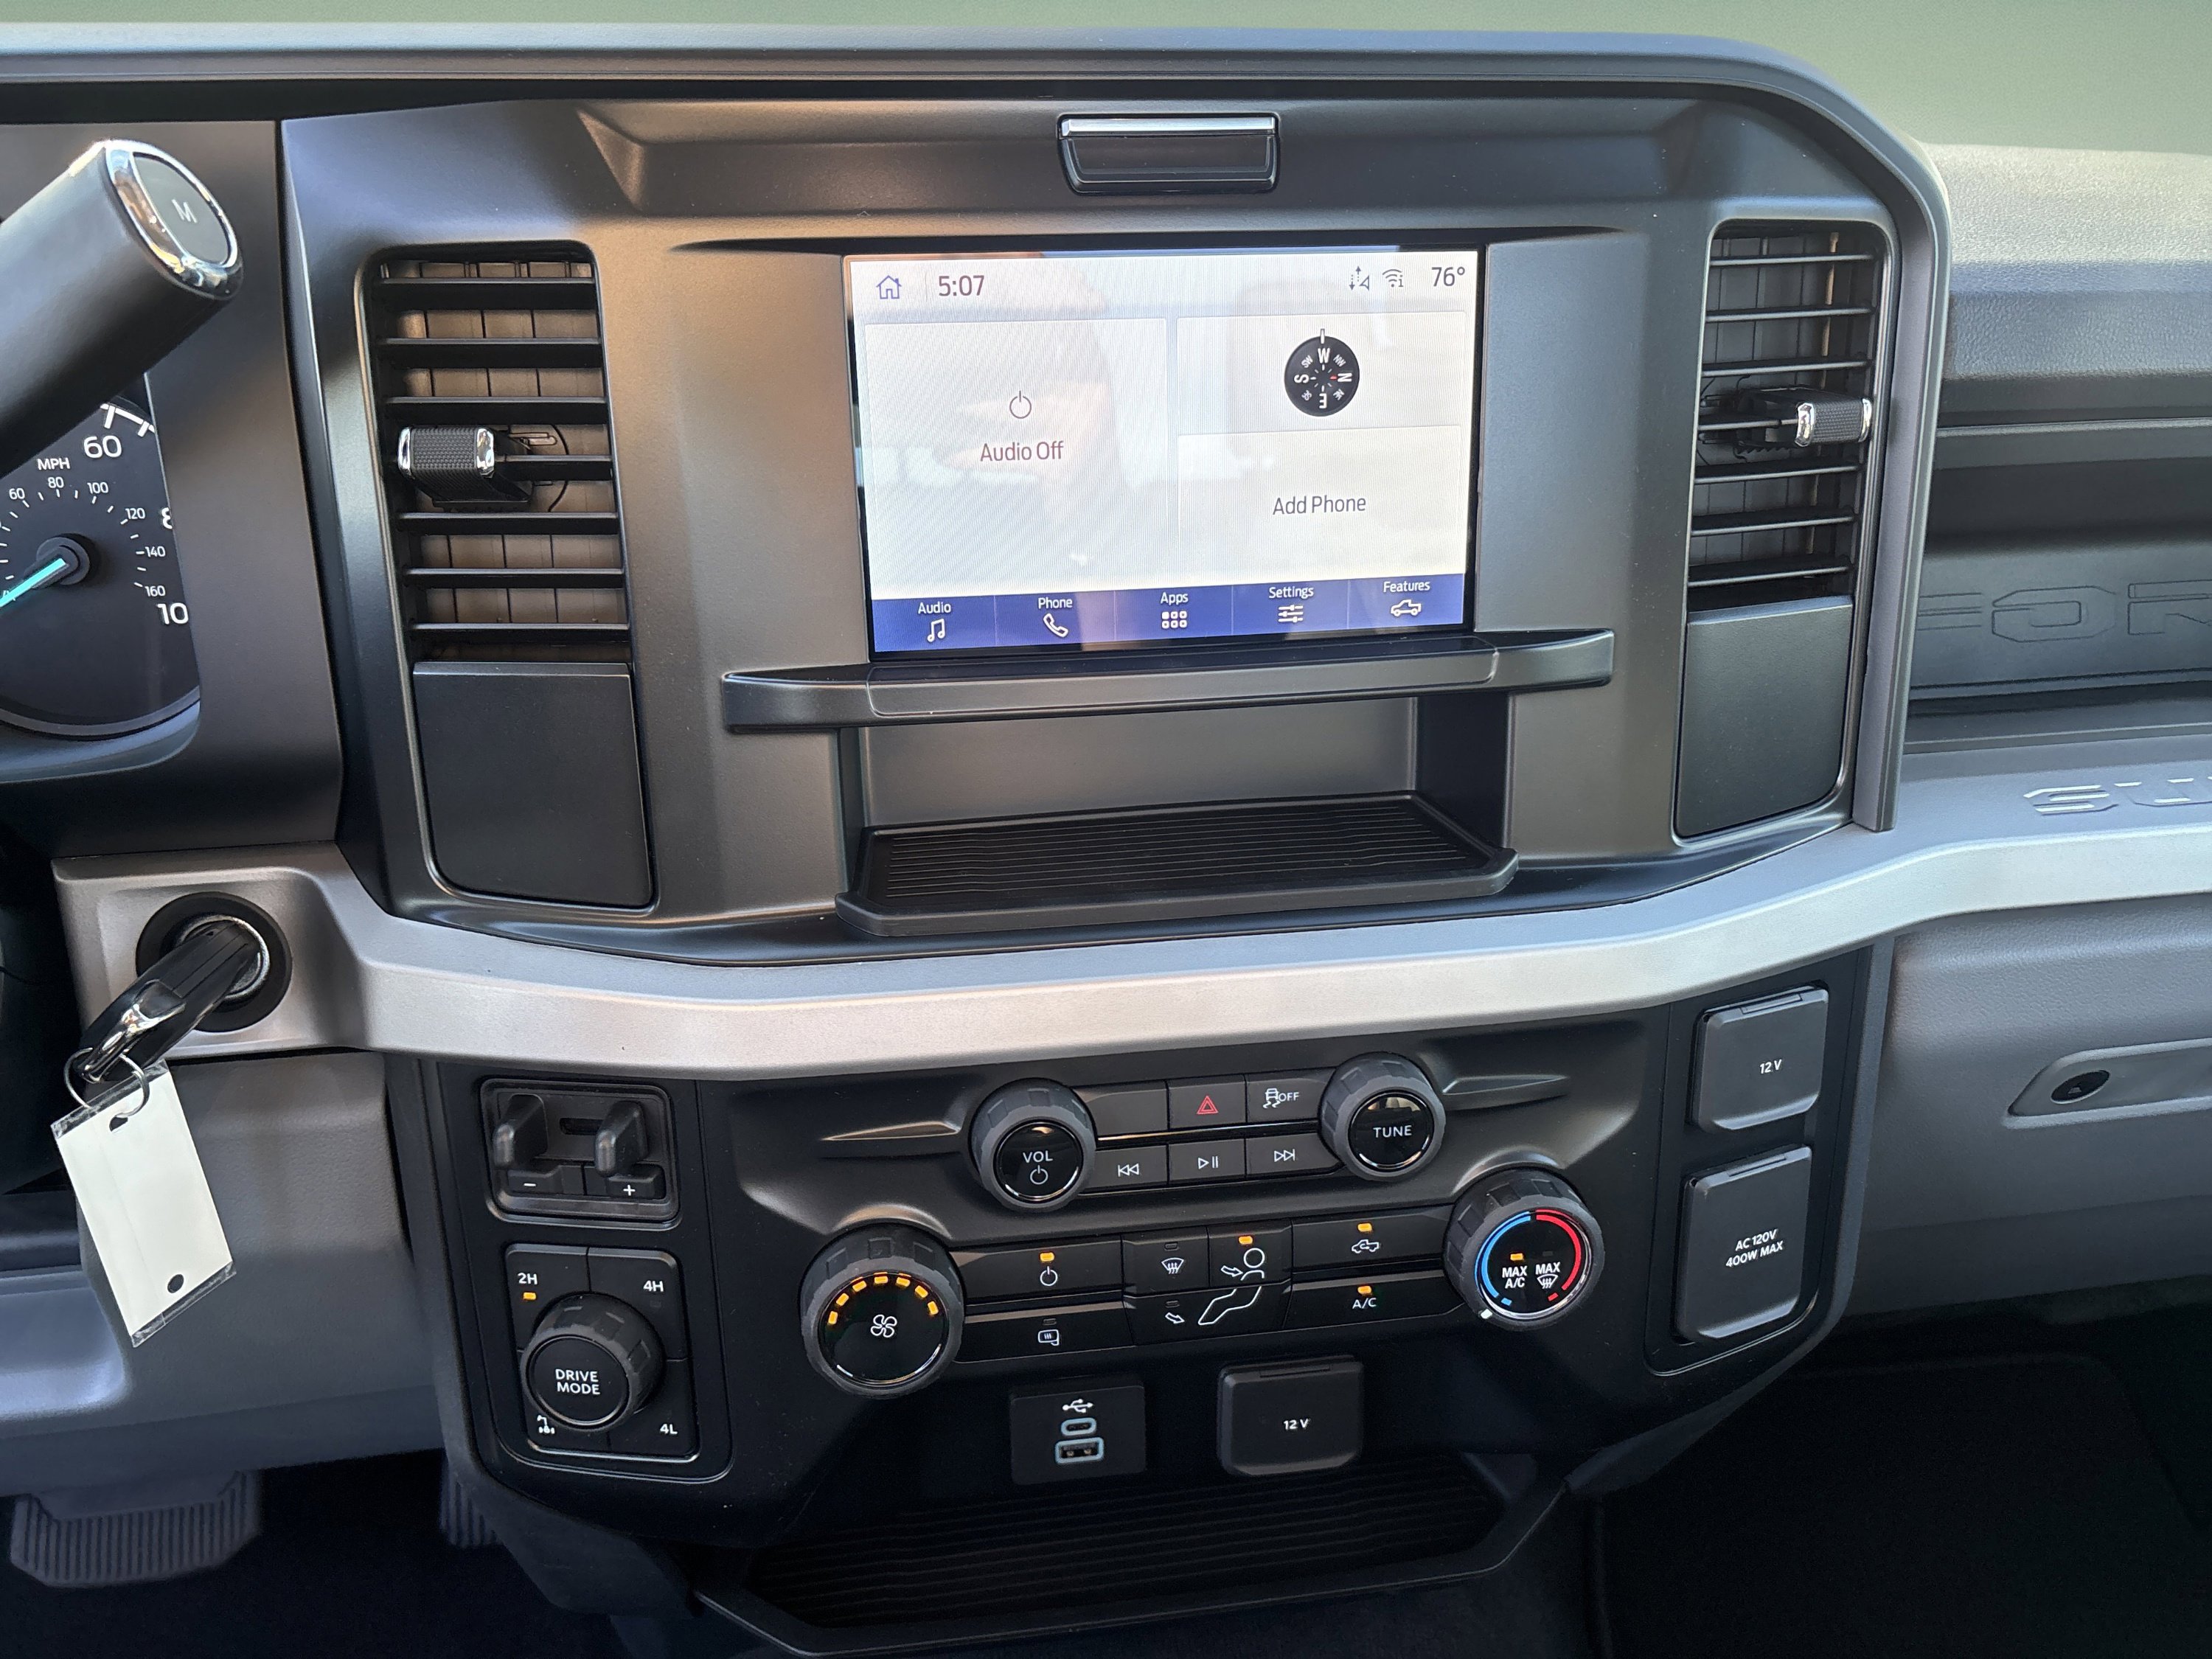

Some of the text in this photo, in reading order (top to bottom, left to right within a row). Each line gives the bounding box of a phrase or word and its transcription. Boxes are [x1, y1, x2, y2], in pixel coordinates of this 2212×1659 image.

[172, 198, 198, 223] M
[939, 275, 985, 296] 5:07
[1317, 347, 1331, 364] W
[1293, 374, 1310, 383] S
[1337, 372, 1353, 383] N
[1318, 393, 1327, 408] E
[83, 435, 123, 459] 60
[980, 440, 1064, 462] Audio Off
[37, 457, 71, 470] MPH
[47, 476, 65, 489] 80
[87, 481, 109, 495] 100
[9, 487, 25, 500] 60
[1273, 495, 1367, 515] Add Phone
[125, 507, 146, 520] 120
[145, 546, 166, 558] 140
[145, 585, 166, 597] 160
[1269, 585, 1315, 599] Settings
[1383, 580, 1431, 593] Features
[1037, 597, 1074, 609] Phone
[1160, 591, 1189, 605] Apps
[918, 601, 952, 614] Audio
[1759, 1059, 1782, 1074] 12 V
[1278, 1091, 1300, 1102] OFF
[1373, 1124, 1413, 1138] TUNE
[1022, 1150, 1054, 1164] VOL
[1735, 1228, 1778, 1251] AC 120V
[1725, 1240, 1784, 1267] 400W MAX
[1502, 1265, 1528, 1278] MAX
[1535, 1262, 1561, 1275] MAX
[517, 1272, 538, 1286] 2H
[643, 1279, 664, 1293] 4H
[1504, 1276, 1526, 1289] A/C
[1352, 1297, 1377, 1310] A/C
[555, 1368, 599, 1383] DRIVE
[556, 1380, 601, 1396] MODE
[660, 1422, 678, 1436] 4L
[1283, 1418, 1310, 1430] 12 V
